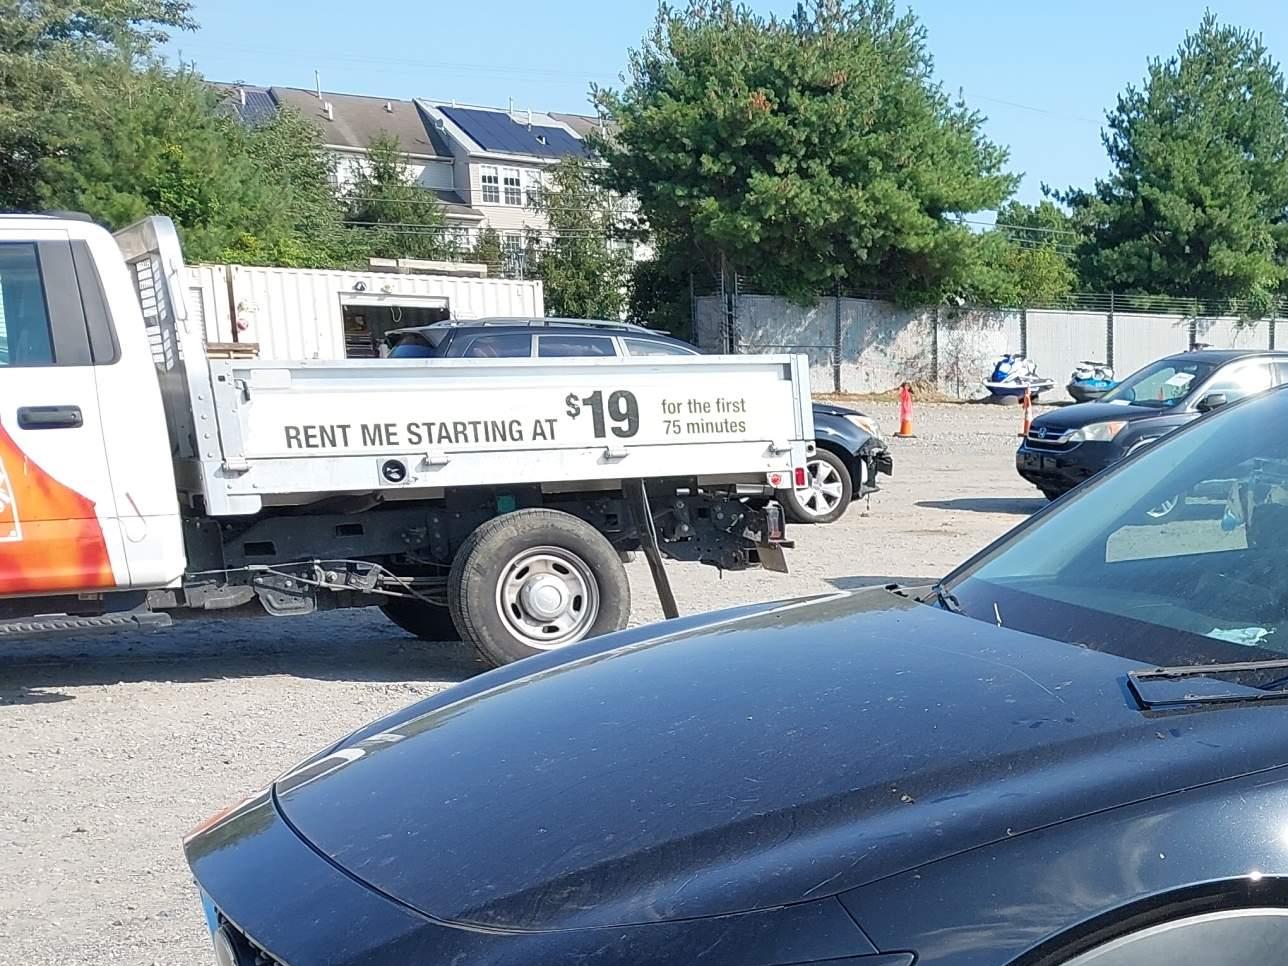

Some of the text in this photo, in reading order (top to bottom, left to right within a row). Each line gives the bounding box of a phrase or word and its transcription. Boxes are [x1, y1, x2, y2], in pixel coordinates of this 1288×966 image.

[661, 397, 747, 414] for the first
[284, 389, 640, 449] RENT ME STARTING AT $19
[662, 418, 747, 435] 75 minutes
